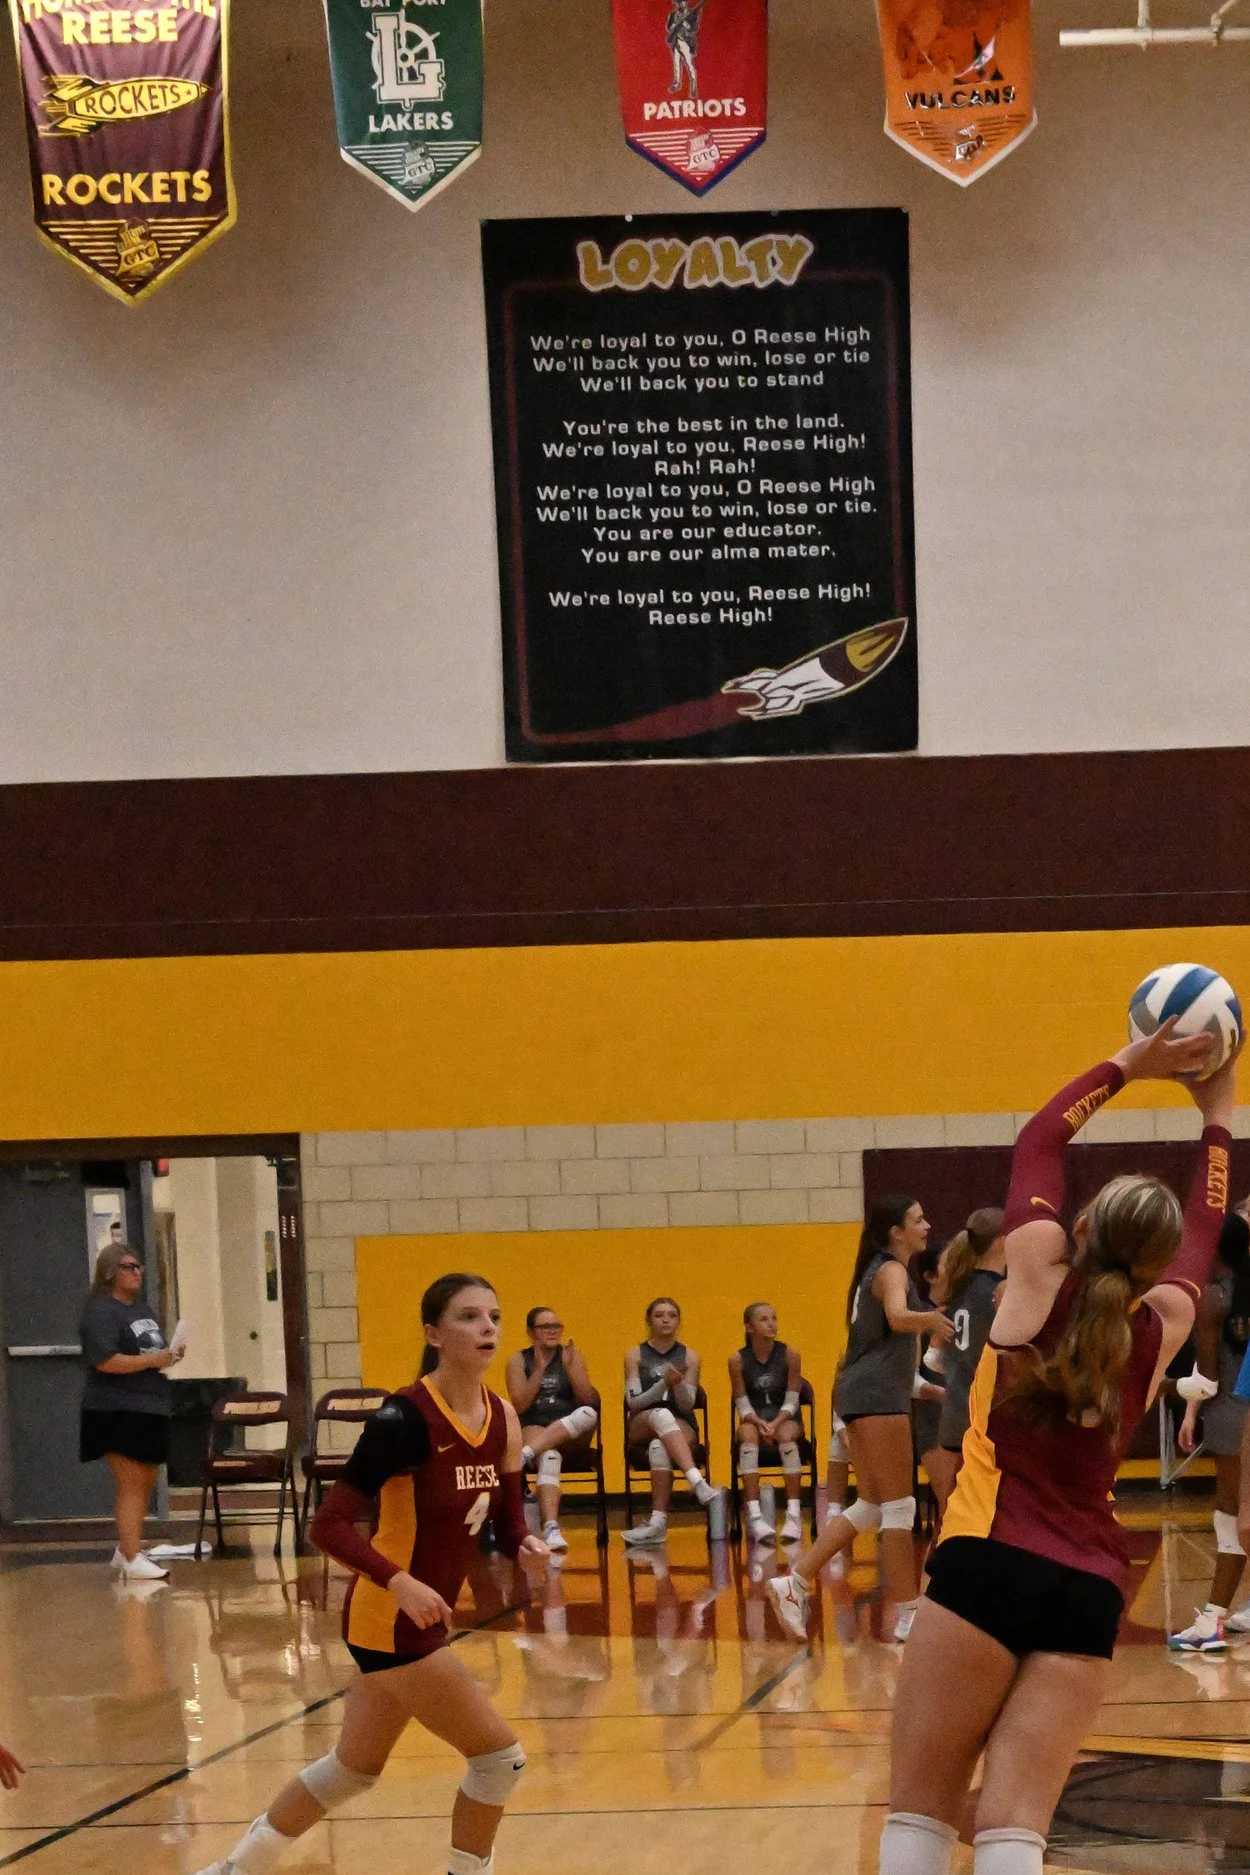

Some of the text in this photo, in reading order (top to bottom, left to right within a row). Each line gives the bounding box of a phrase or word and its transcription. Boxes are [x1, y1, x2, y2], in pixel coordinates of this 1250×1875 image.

[62, 9, 178, 44] REESE
[84, 83, 182, 115] ROCKETS
[643, 97, 747, 120] PATRIOTS
[904, 85, 1016, 110] VULCANS
[368, 112, 454, 133] LAKERS
[42, 170, 213, 205] ROCKETS
[576, 234, 814, 292] LOYALTY
[530, 325, 871, 353] We're loyal to you, O Reese High
[532, 347, 870, 373] We'll back you to win, lose or tie
[579, 370, 824, 393] We'll back you to stand
[562, 412, 845, 436] You're the best in the land.
[541, 433, 866, 459] We're loyal to you, Reese High!
[654, 457, 756, 476] Rah! Rah!
[536, 475, 876, 503] We're loyal to you, O Reese High
[535, 497, 877, 523] We'll back you to win, lose or tie.
[593, 521, 822, 542] You are our educator.
[581, 543, 836, 564] You are our alma mater.
[548, 582, 871, 609] We're loyal to you, Reese High!
[648, 606, 773, 627] Reese High!
[1063, 1085, 1110, 1132] ROCKETS
[455, 1464, 499, 1490] REESE
[464, 1491, 491, 1536] 4
